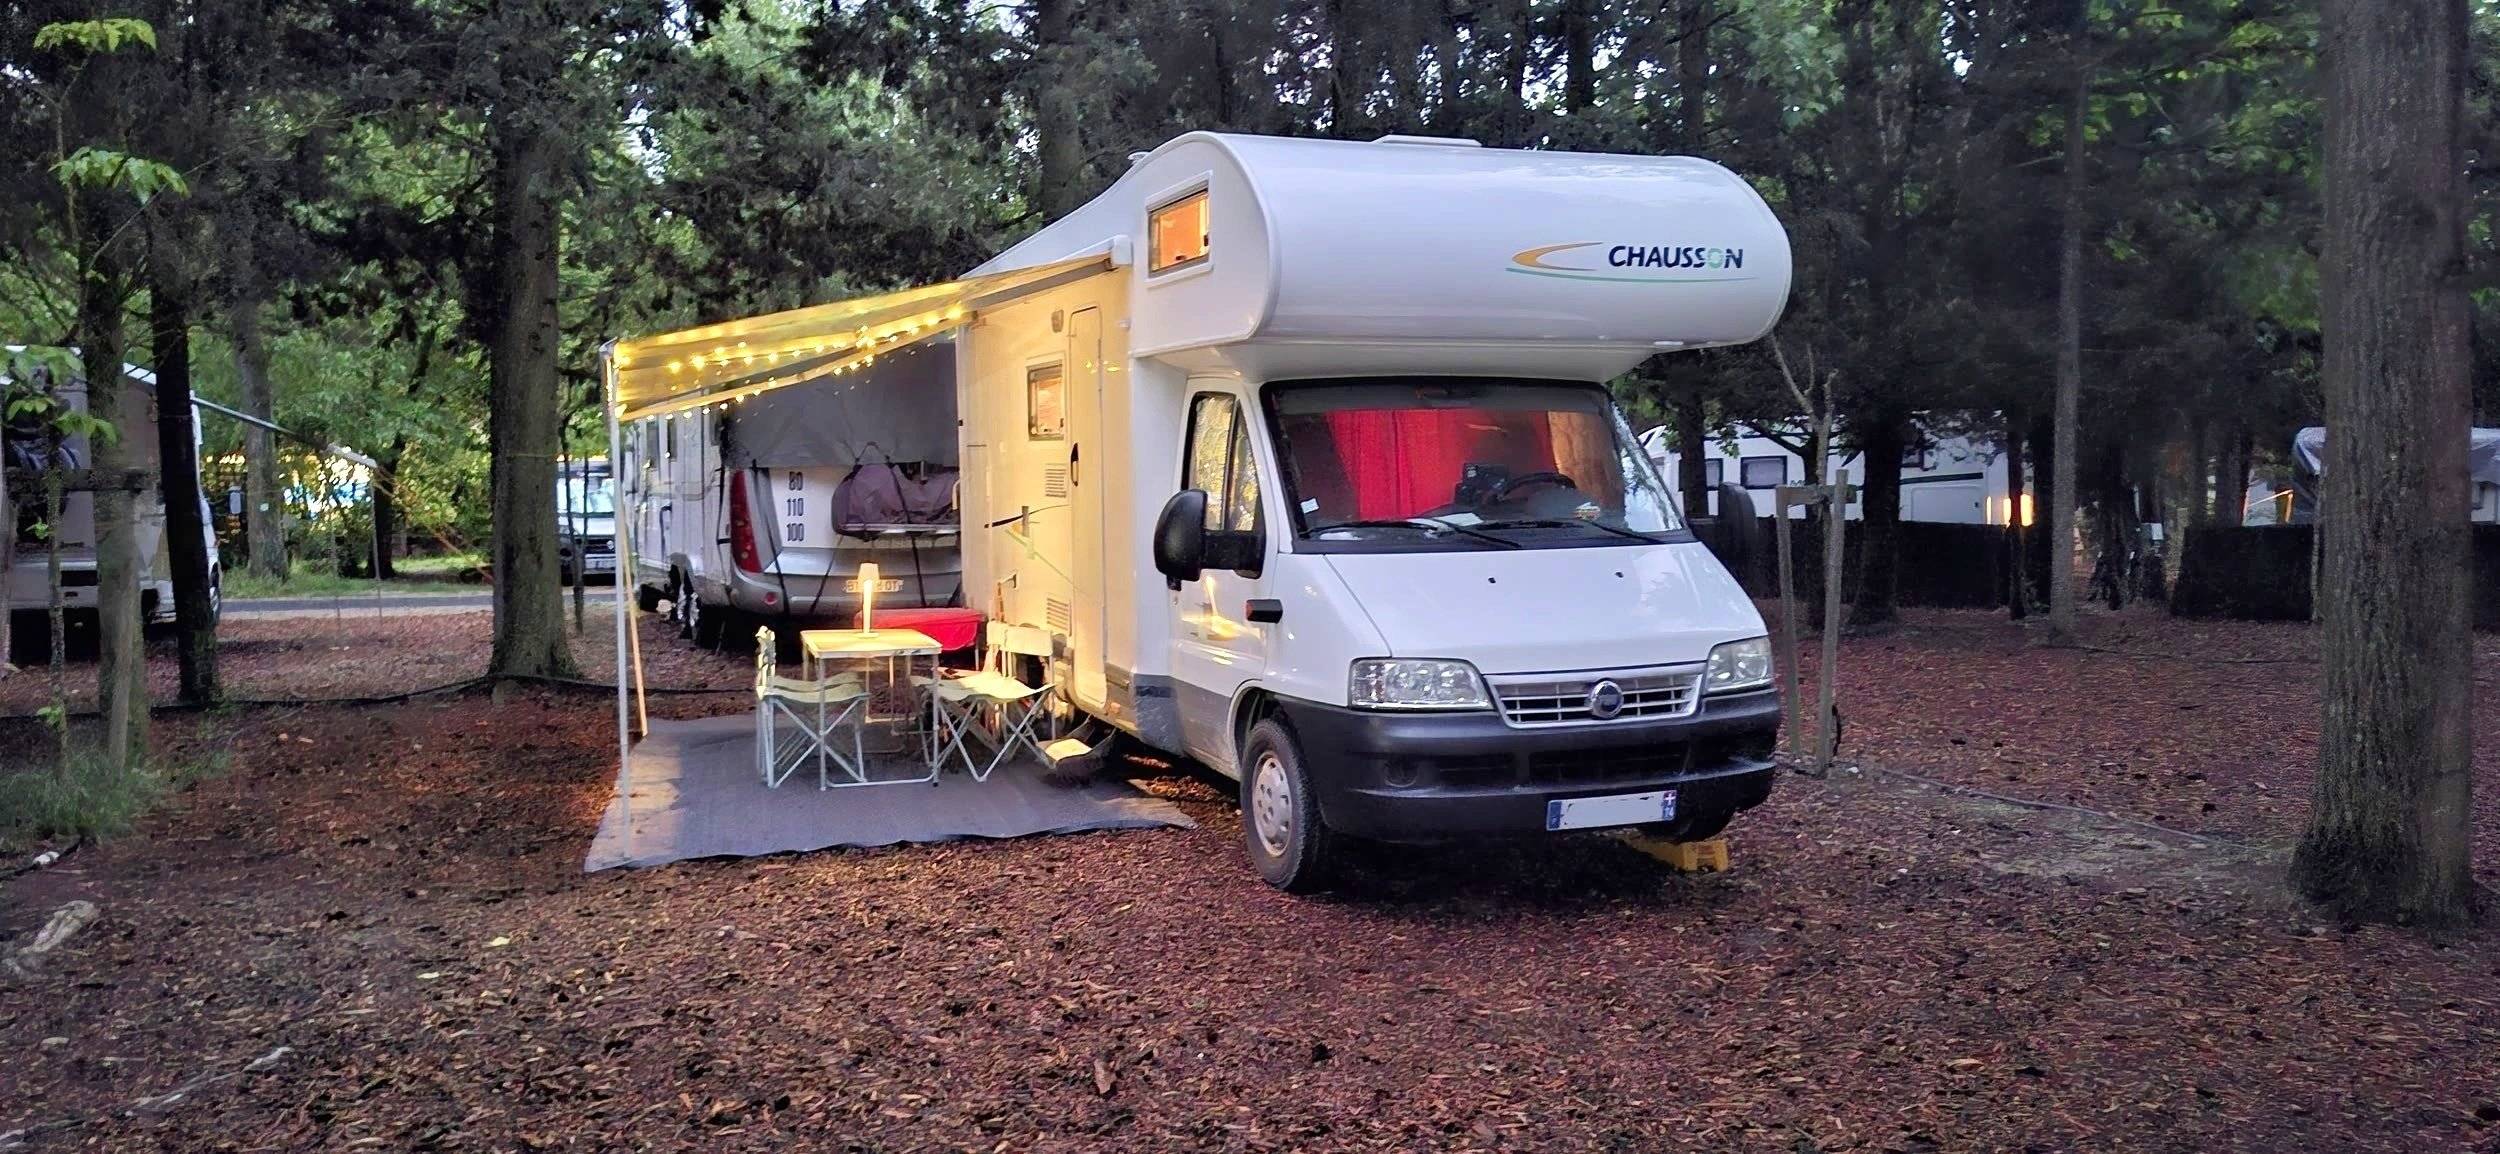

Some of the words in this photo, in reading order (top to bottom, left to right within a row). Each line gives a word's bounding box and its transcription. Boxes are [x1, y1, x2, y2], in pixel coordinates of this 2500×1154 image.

[1608, 245, 1743, 269] CHAUSSON
[788, 471, 804, 491] 80
[786, 497, 804, 517] 110
[786, 523, 805, 542] 100
